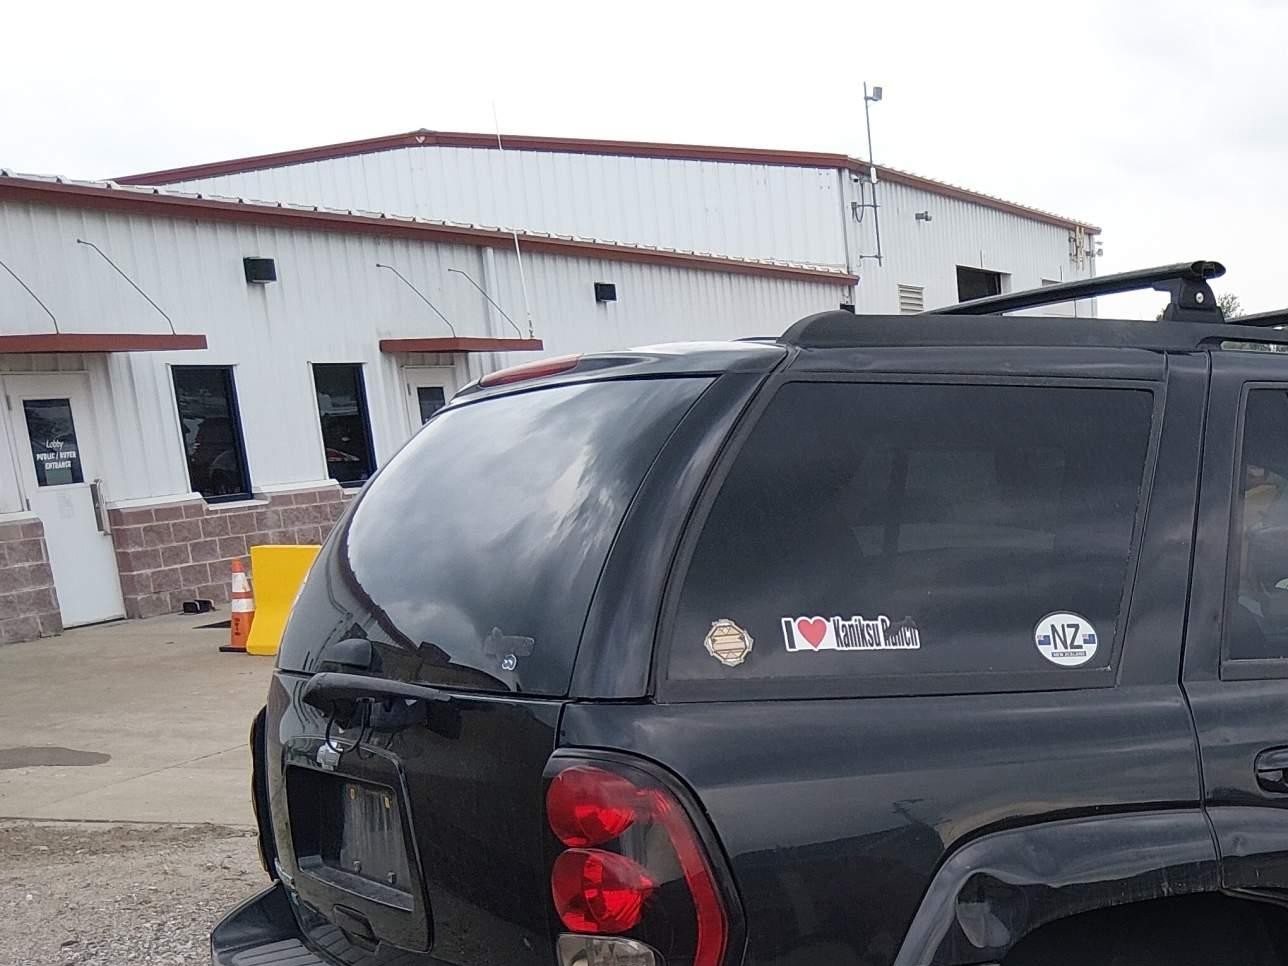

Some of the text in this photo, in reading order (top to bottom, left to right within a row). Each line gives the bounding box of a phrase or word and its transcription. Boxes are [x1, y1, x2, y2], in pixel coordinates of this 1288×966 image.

[45, 439, 64, 451] Lobby
[784, 619, 798, 650] I
[832, 616, 882, 648] Kaniksu
[1050, 623, 1084, 650] NZ
